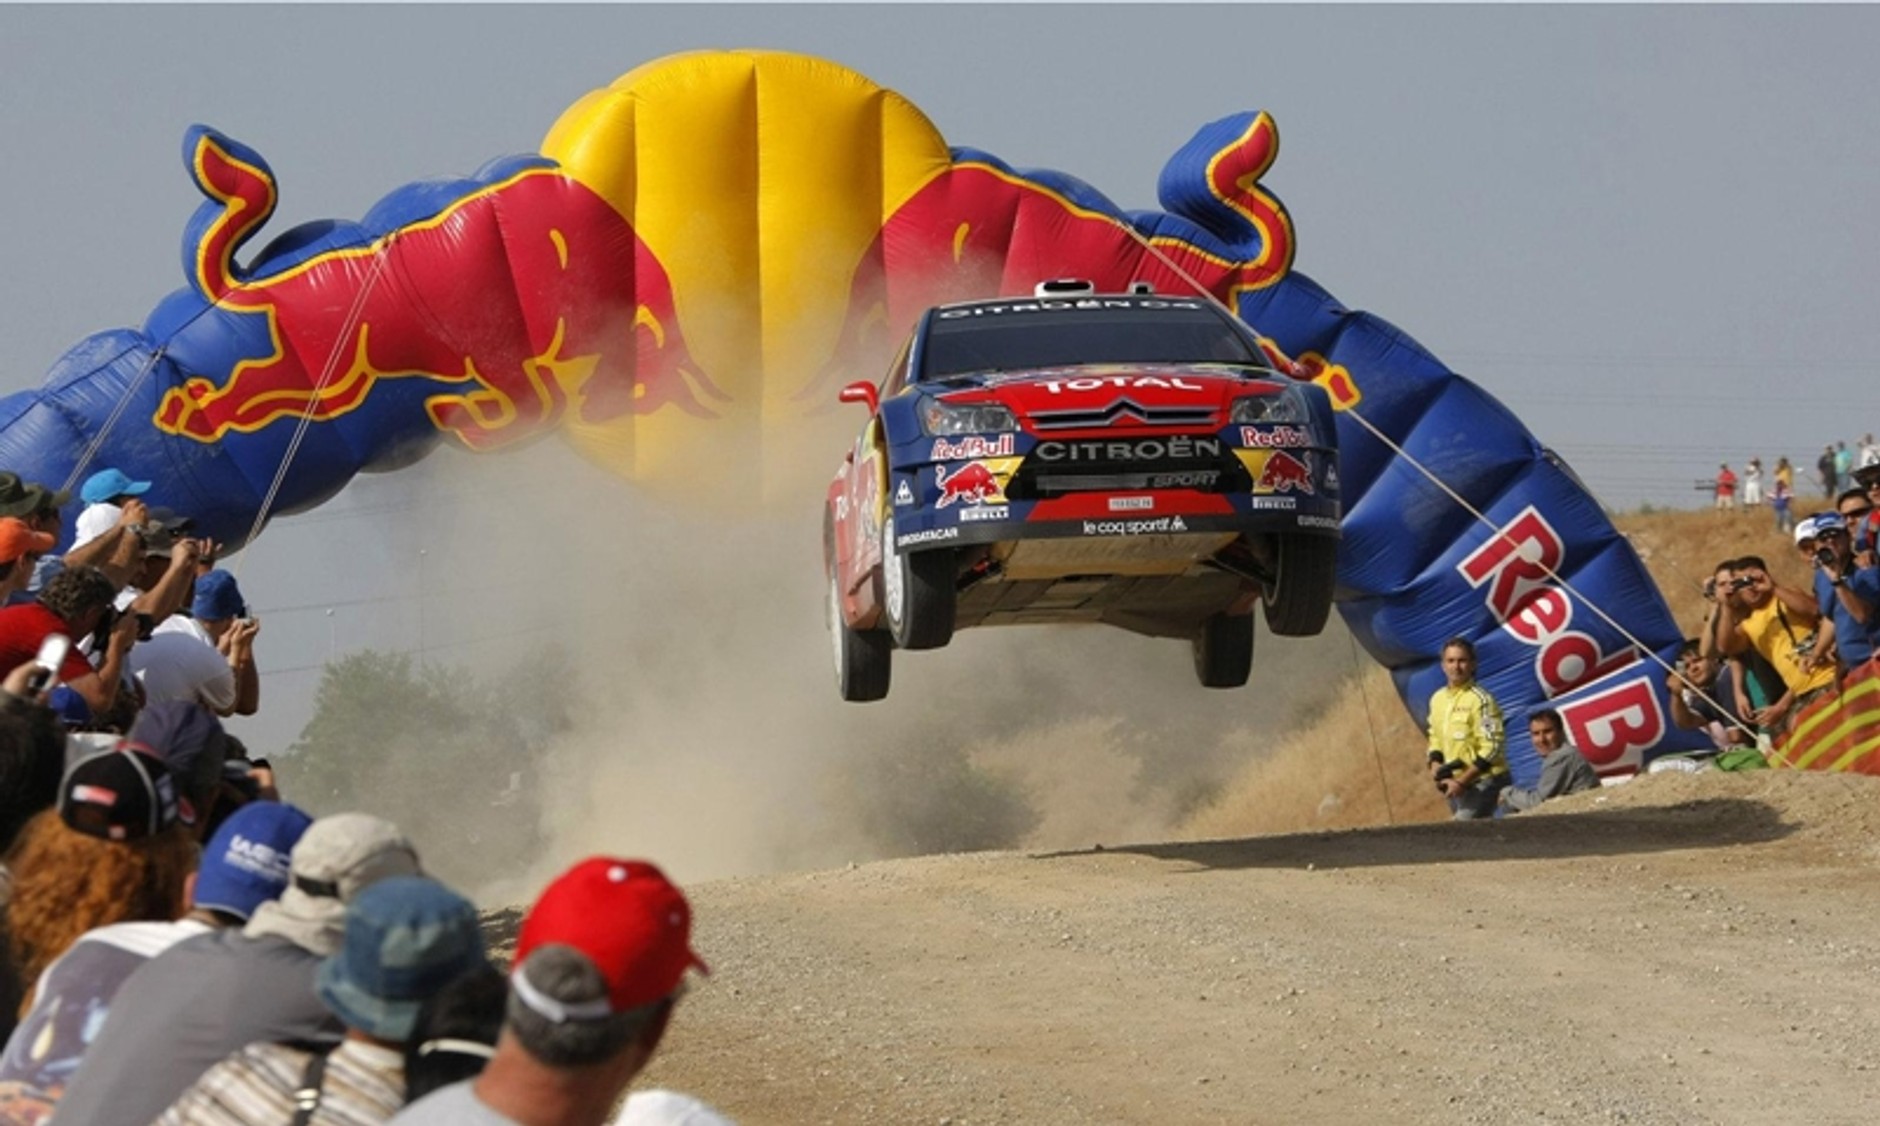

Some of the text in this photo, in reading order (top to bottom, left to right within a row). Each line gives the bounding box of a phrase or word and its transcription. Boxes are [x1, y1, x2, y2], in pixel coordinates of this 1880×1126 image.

[1034, 374, 1203, 394] TOTAL
[1036, 435, 1221, 461] CITROËN
[1153, 470, 1221, 488] SPORT
[1252, 496, 1297, 509] PIRELLI
[1083, 517, 1170, 537] le coq sportif
